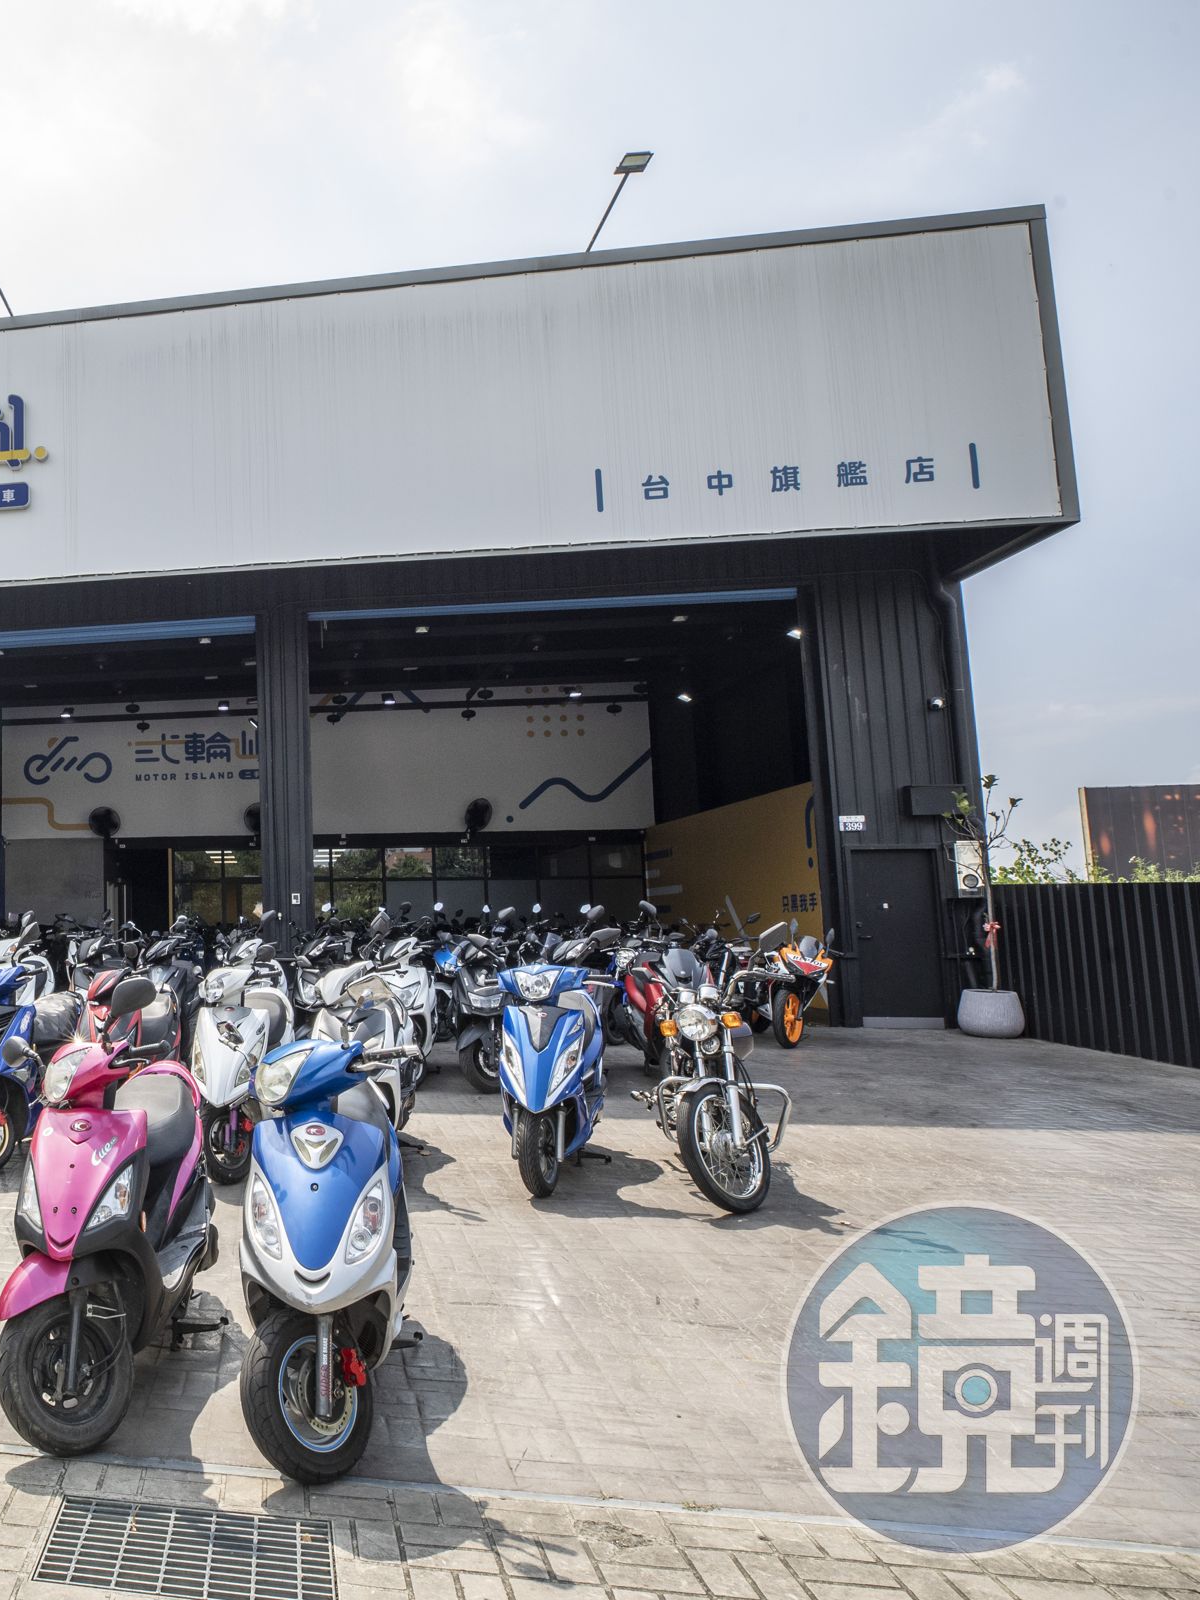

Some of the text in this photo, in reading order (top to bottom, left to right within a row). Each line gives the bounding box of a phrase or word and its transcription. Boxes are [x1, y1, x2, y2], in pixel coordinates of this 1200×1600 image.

[641, 456, 935, 500] 台中旗艦店
[135, 773, 177, 782] MOTOR
[185, 771, 234, 781] ISLAND
[845, 822, 863, 831] 399
